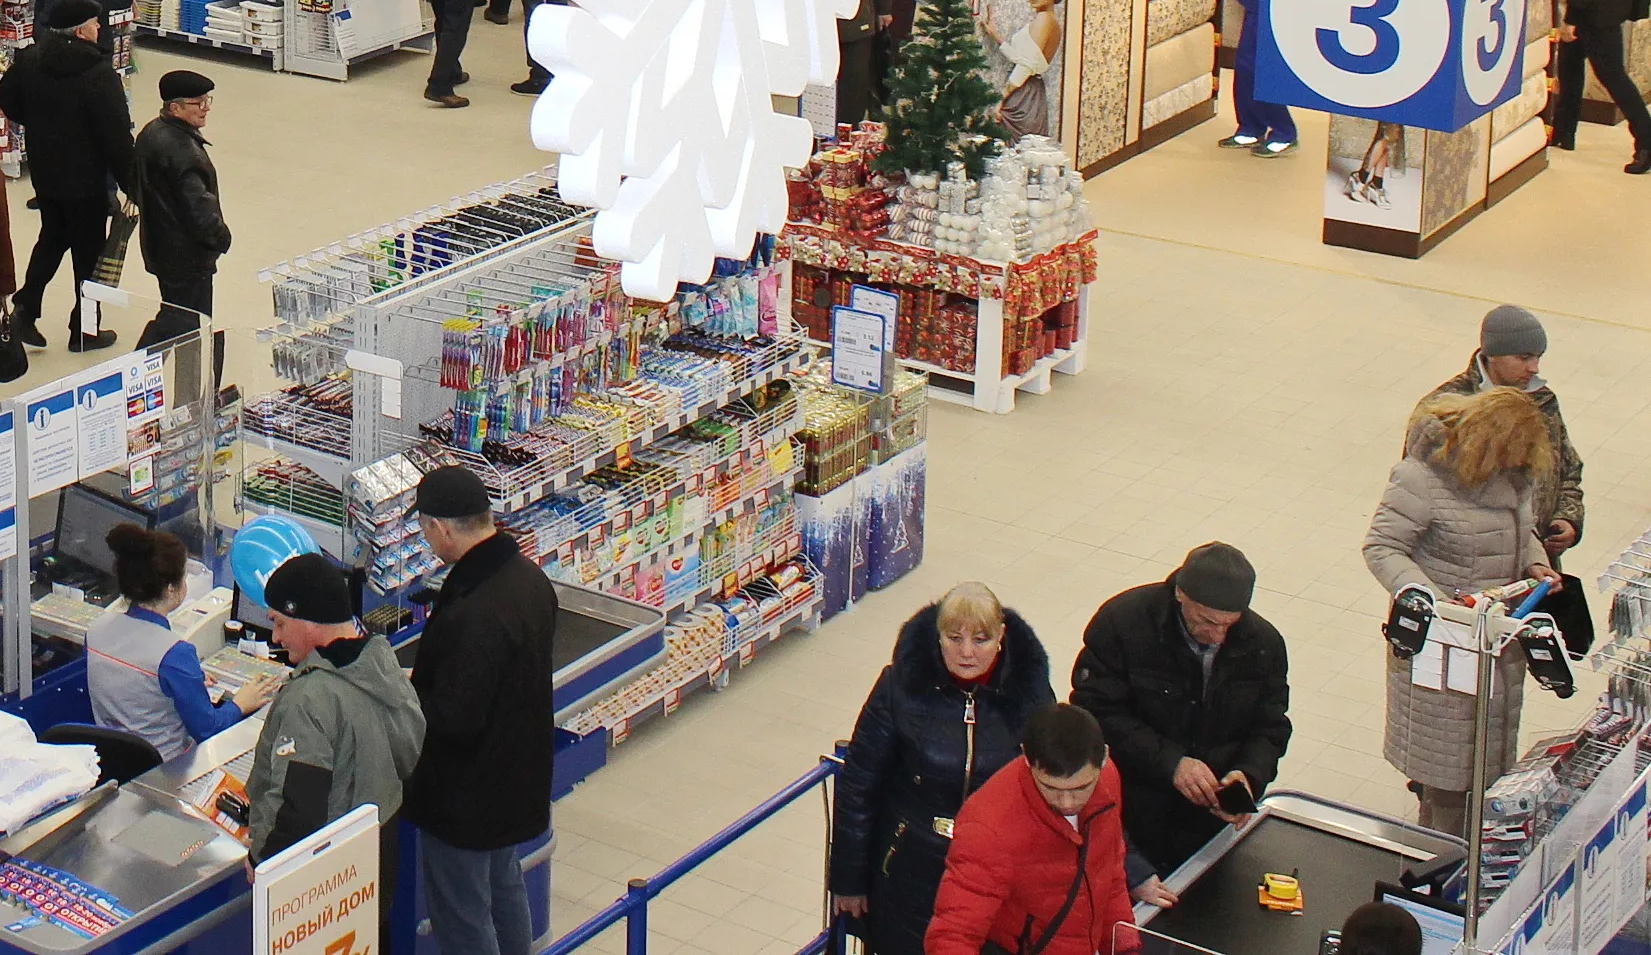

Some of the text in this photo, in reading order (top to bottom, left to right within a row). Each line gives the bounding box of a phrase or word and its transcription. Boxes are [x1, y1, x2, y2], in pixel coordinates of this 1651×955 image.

[147, 361, 160, 372] VISA
[147, 375, 162, 387] VISA
[128, 382, 144, 395] VISA
[272, 865, 357, 926] ПРОГРАММА
[272, 904, 333, 955] НОВЫЙ
[337, 881, 375, 922] ДОМ
